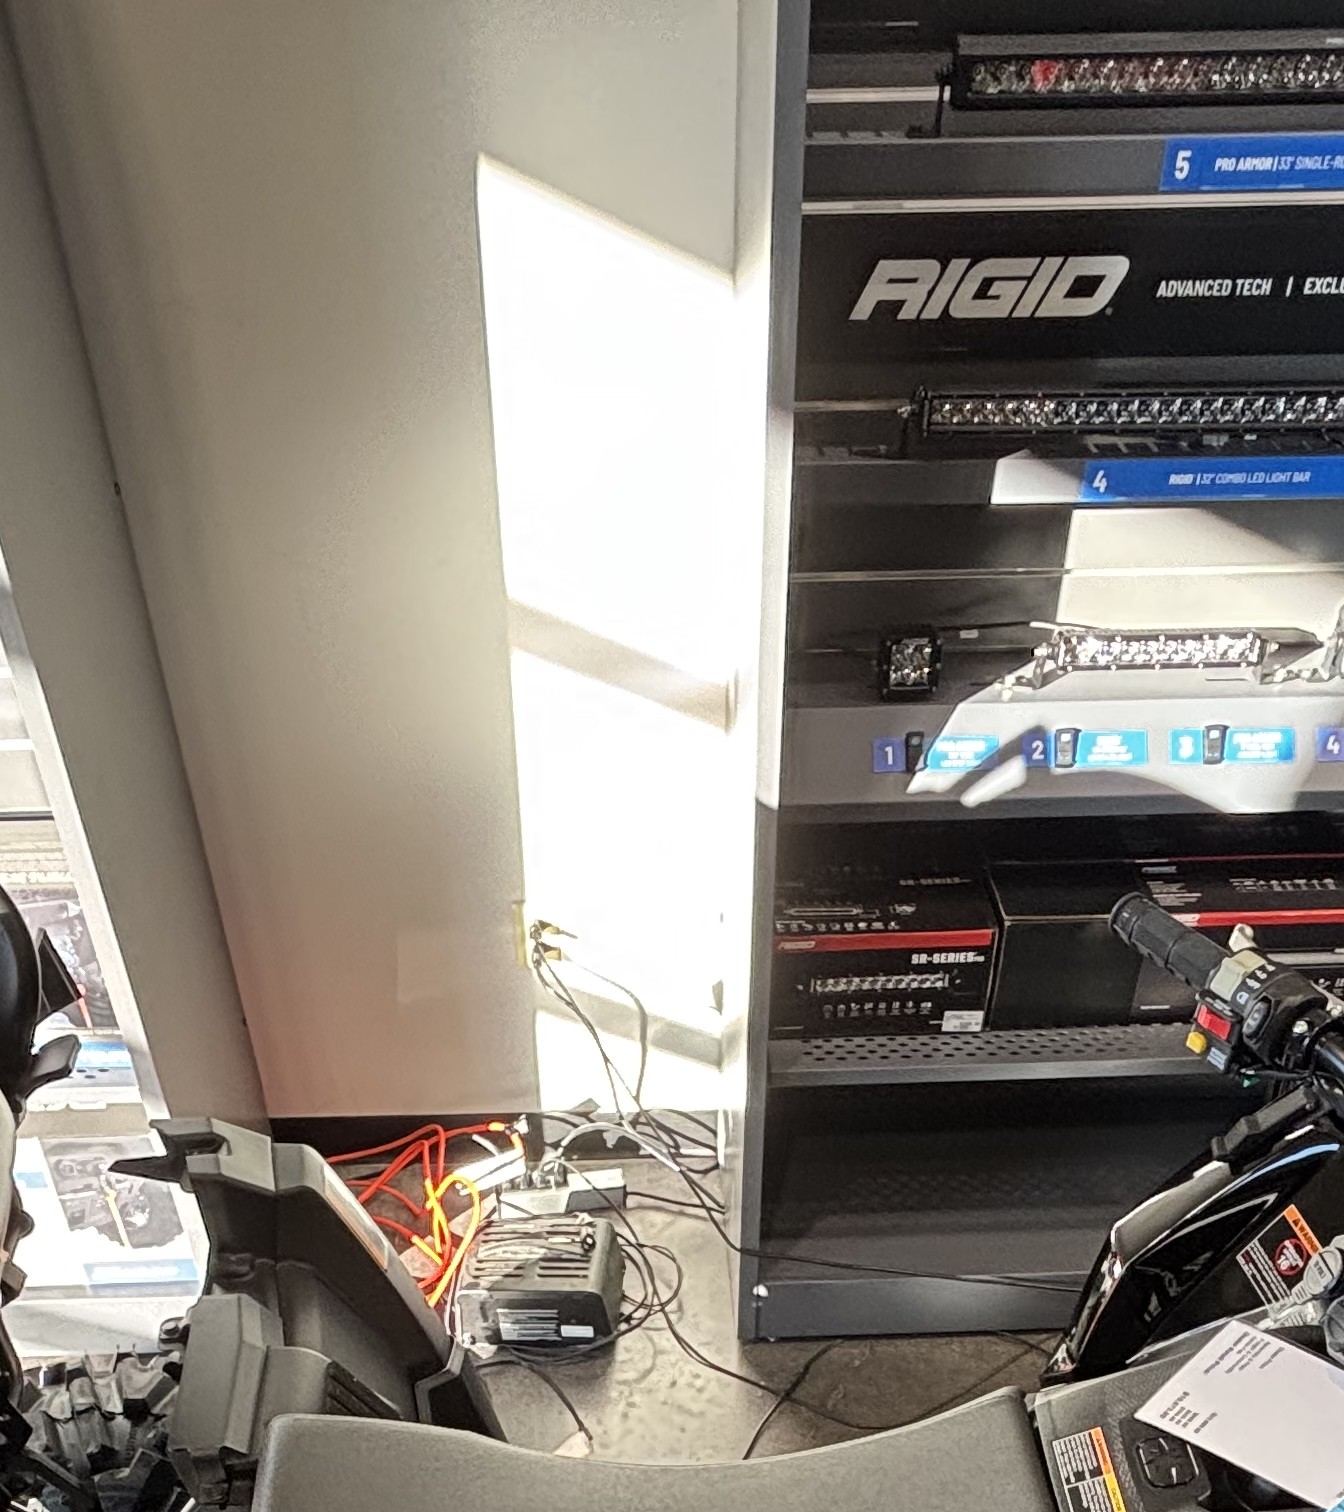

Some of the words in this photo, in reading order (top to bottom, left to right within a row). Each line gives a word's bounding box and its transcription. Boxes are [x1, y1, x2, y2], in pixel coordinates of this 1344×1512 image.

[1174, 150, 1191, 180] 5
[1215, 158, 1235, 172] PRO
[1236, 157, 1273, 171] ARMOR
[848, 255, 1130, 321] RIGID
[1156, 278, 1233, 299] ADVANCED
[1236, 277, 1272, 297] TECH
[1093, 470, 1107, 493] 4
[1247, 472, 1264, 484] LED
[1265, 472, 1291, 483] LIGHT
[1292, 471, 1311, 483] BAR
[885, 746, 894, 765] 1
[1031, 740, 1045, 761] 2
[1326, 736, 1340, 755] 4
[911, 952, 975, 965] SR-SERIES
